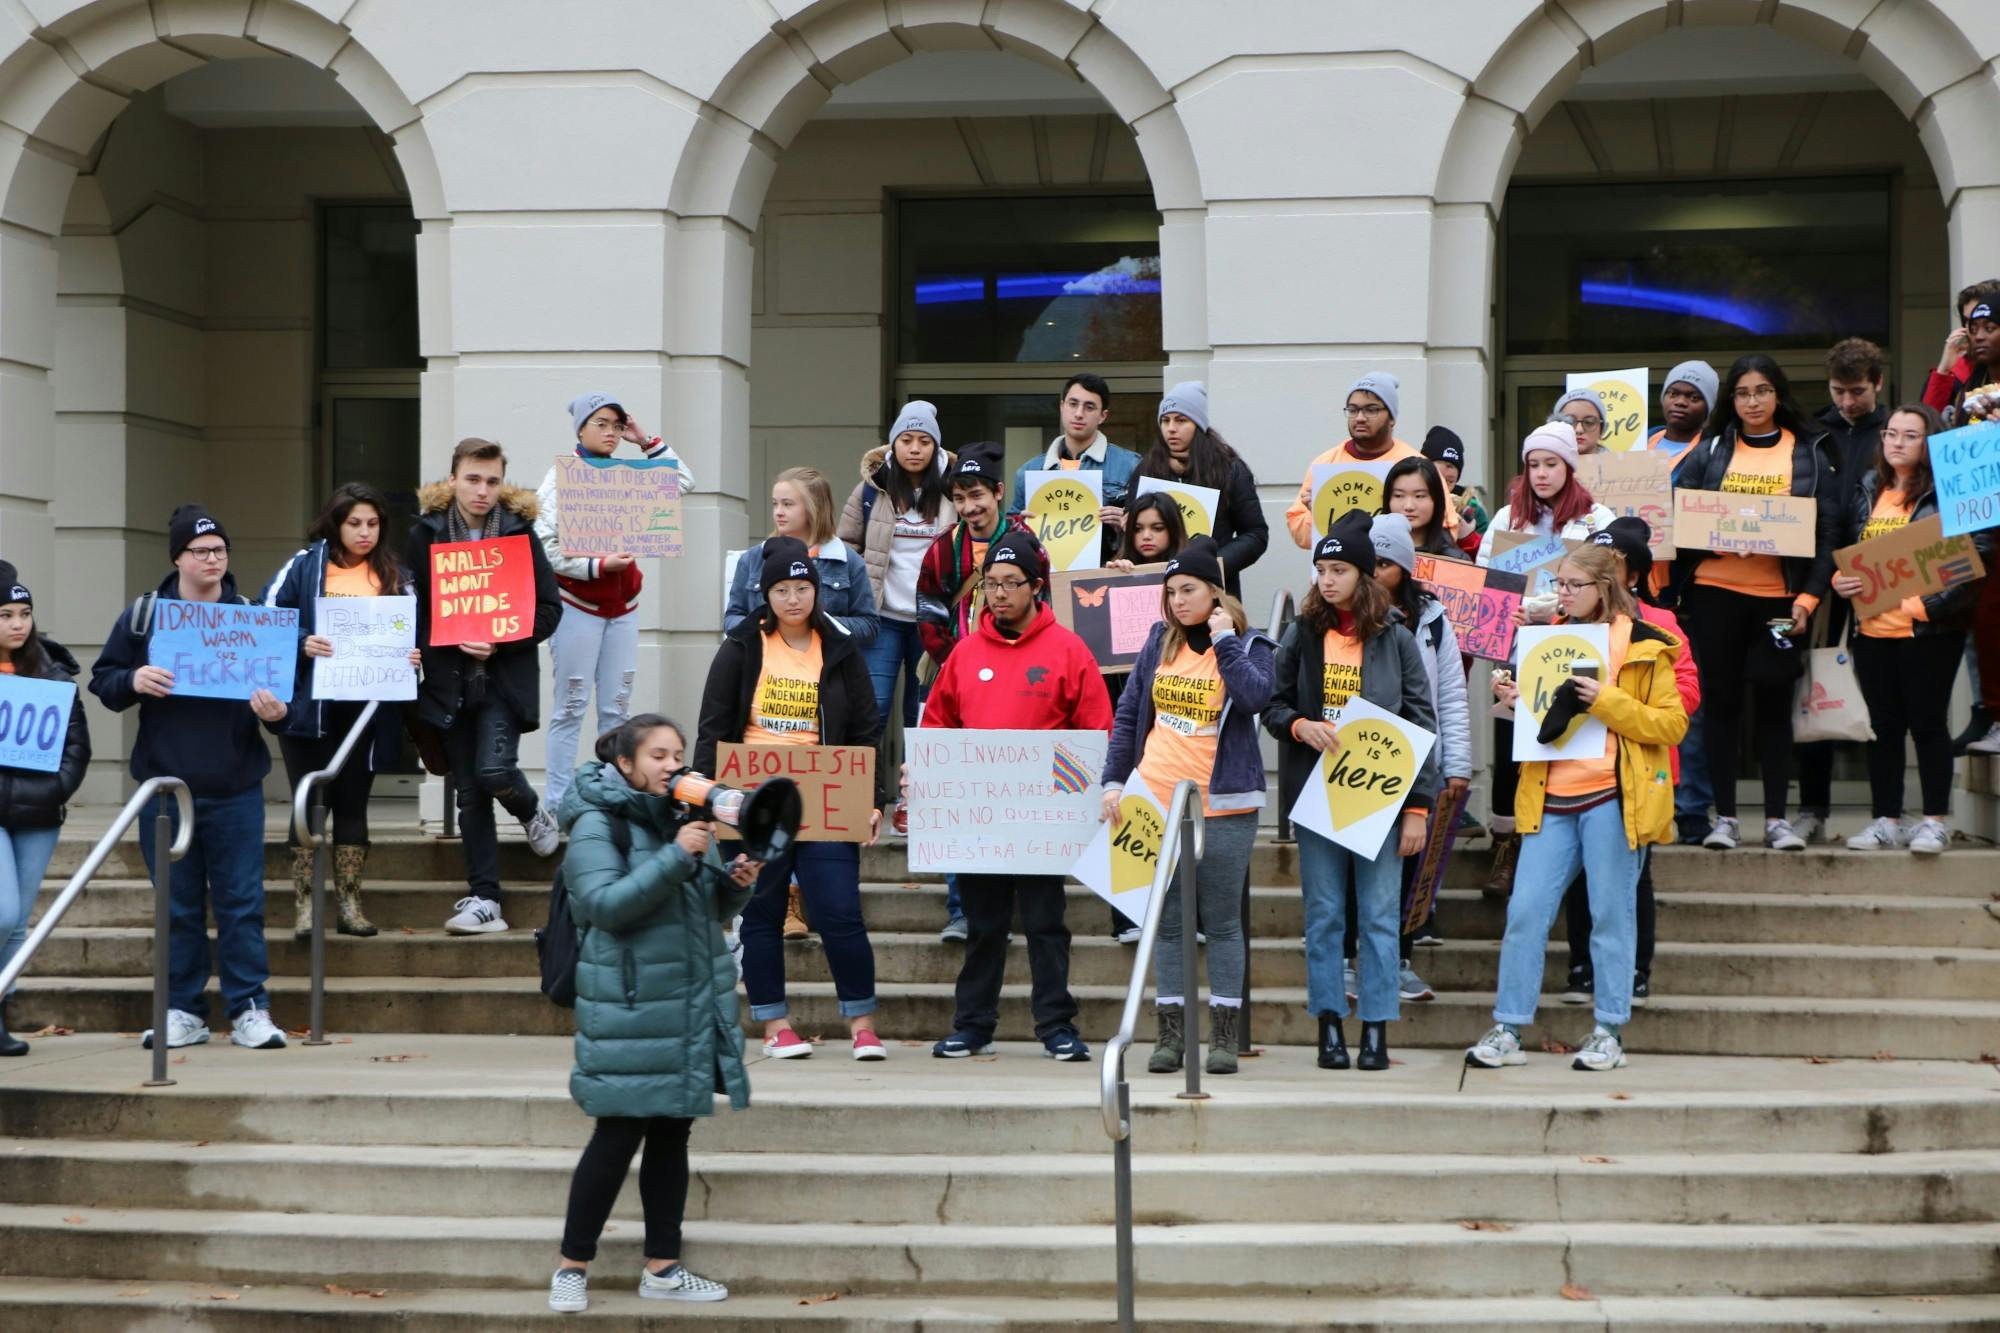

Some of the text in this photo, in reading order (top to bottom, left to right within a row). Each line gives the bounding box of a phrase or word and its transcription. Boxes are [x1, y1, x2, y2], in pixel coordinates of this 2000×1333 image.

[1598, 390, 1629, 402] OME
[906, 421, 924, 430] here
[961, 463, 981, 473] here
[620, 470, 633, 485] TO
[1940, 473, 1967, 498] WE
[635, 489, 659, 500] THAT
[1045, 489, 1085, 503] HOME
[1332, 481, 1374, 498] HOME
[1058, 502, 1070, 512] IS
[1346, 496, 1359, 506] IS
[1178, 503, 1196, 519] ME
[195, 522, 217, 534] here
[560, 515, 643, 533] WRONG IS
[1038, 512, 1096, 543] here
[1741, 519, 1761, 532] ALL
[561, 534, 620, 554] WRONG
[1321, 544, 1343, 555] here
[1708, 531, 1777, 552] Humans
[434, 546, 505, 574] WALLS
[994, 552, 1017, 562] here
[790, 566, 809, 577] here
[439, 571, 495, 596] WONT
[11, 588, 31, 601] here
[440, 592, 512, 618] DIVIDE
[158, 602, 298, 631] I DRINK MY WATER
[492, 615, 520, 638] US
[199, 629, 257, 648] WARM
[244, 655, 283, 688] ICE
[322, 665, 411, 688] DEFEND DACA
[1556, 663, 1570, 673] IS
[766, 673, 820, 691] UNSTOPPAB
[764, 687, 818, 704] UNDENIABL
[1358, 731, 1403, 758] HOME
[1366, 747, 1382, 760] IS
[720, 748, 867, 779] ABOLISH
[913, 742, 951, 769] NO
[1327, 750, 1403, 796] here
[912, 780, 1014, 801] NUESTRA
[915, 806, 1089, 831] SIN NO QUIERES
[1141, 825, 1152, 838] IS
[1027, 840, 1089, 858] GENT
[1112, 820, 1158, 869] her
